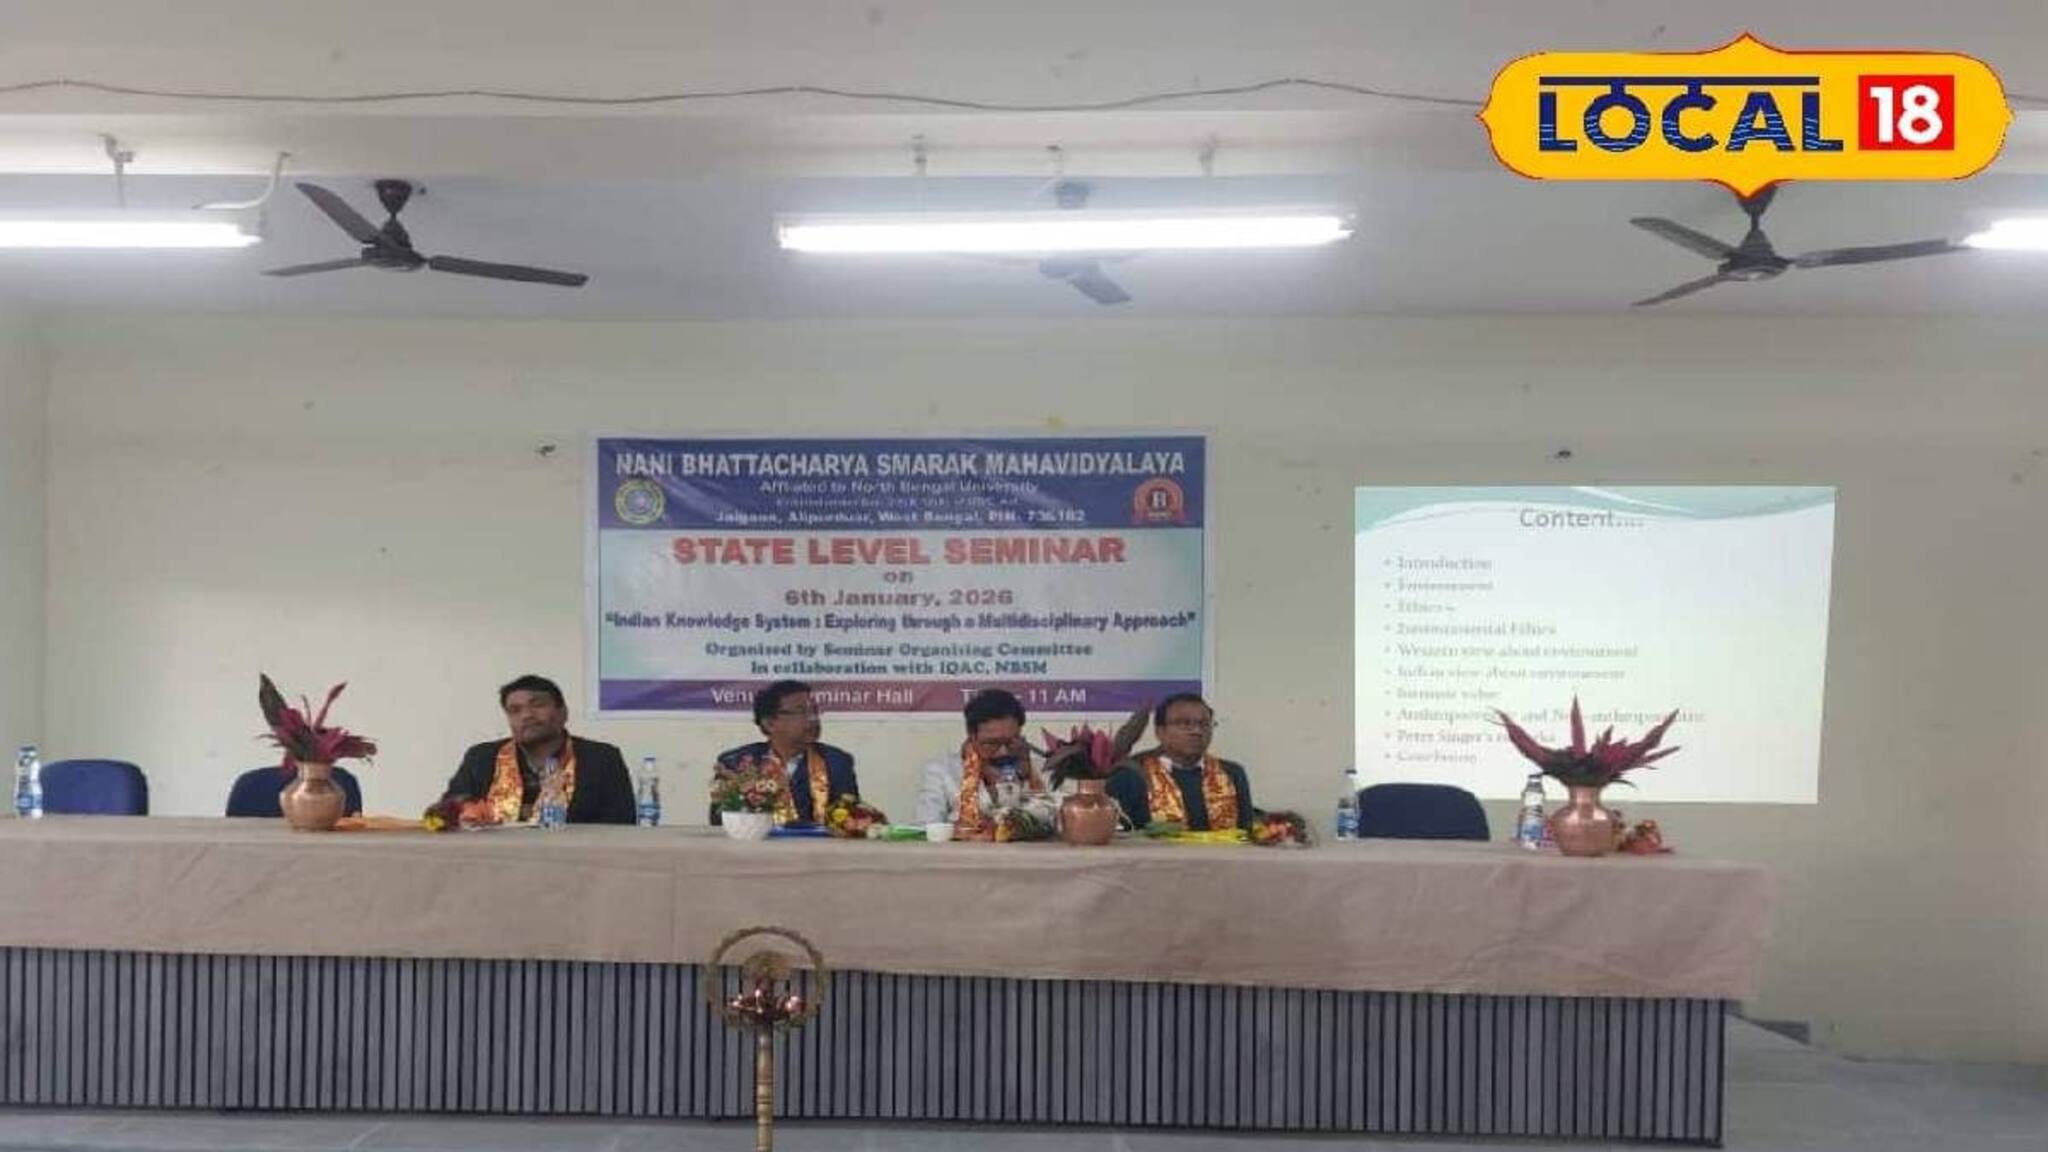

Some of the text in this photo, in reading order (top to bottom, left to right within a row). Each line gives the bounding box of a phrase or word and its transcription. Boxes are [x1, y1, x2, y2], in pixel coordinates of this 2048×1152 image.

[615, 451, 1186, 477] NANI BHATTACHARYA SMARAK MAHAVIDYALAYA
[851, 480, 896, 495] North
[959, 480, 1039, 495] University
[878, 509, 916, 523] West
[672, 537, 1127, 565] STATE LEVEL SEMINAR
[784, 589, 1014, 608] 6th January, 2026
[665, 612, 750, 632] Knowledge
[755, 612, 810, 632] System
[825, 613, 896, 632] Exploring
[902, 613, 961, 632] through
[978, 612, 1108, 631] Multidisciplinary
[797, 642, 817, 657] by
[823, 642, 897, 656] Seminar
[999, 642, 1093, 656] Committee
[774, 660, 886, 674] collaboration
[892, 660, 933, 673] with
[995, 660, 1047, 674] NBSM
[877, 688, 913, 704] Hall
[1029, 688, 1047, 704] 11
[1054, 688, 1087, 704] AM
